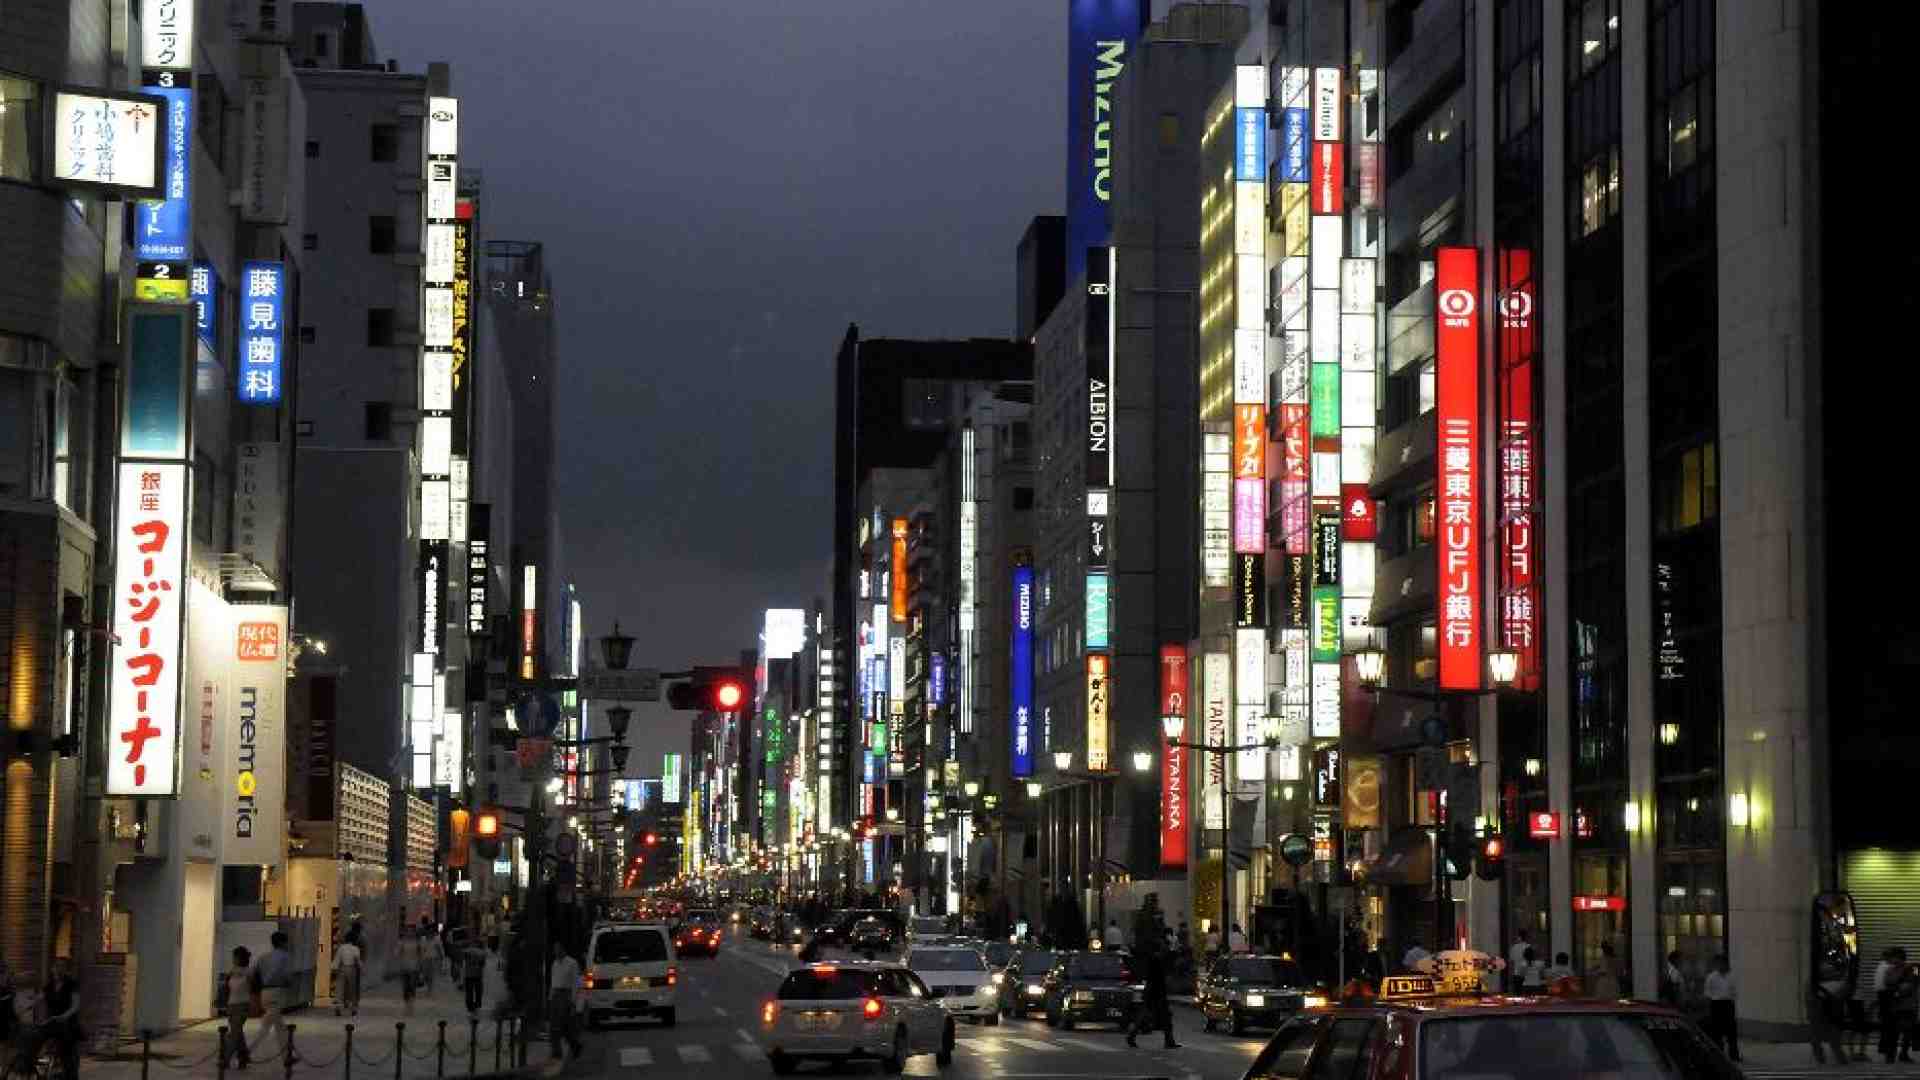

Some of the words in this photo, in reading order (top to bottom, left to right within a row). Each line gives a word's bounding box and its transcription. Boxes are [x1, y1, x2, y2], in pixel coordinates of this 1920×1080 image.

[158, 72, 174, 87] 3
[154, 264, 170, 279] 2
[246, 269, 278, 398] 藤見歯科
[1090, 378, 1106, 452] ALBION
[1446, 419, 1472, 647] 三菱東京UFJ銀行
[121, 516, 171, 787] コージーコーナー
[236, 686, 258, 840] memoria
